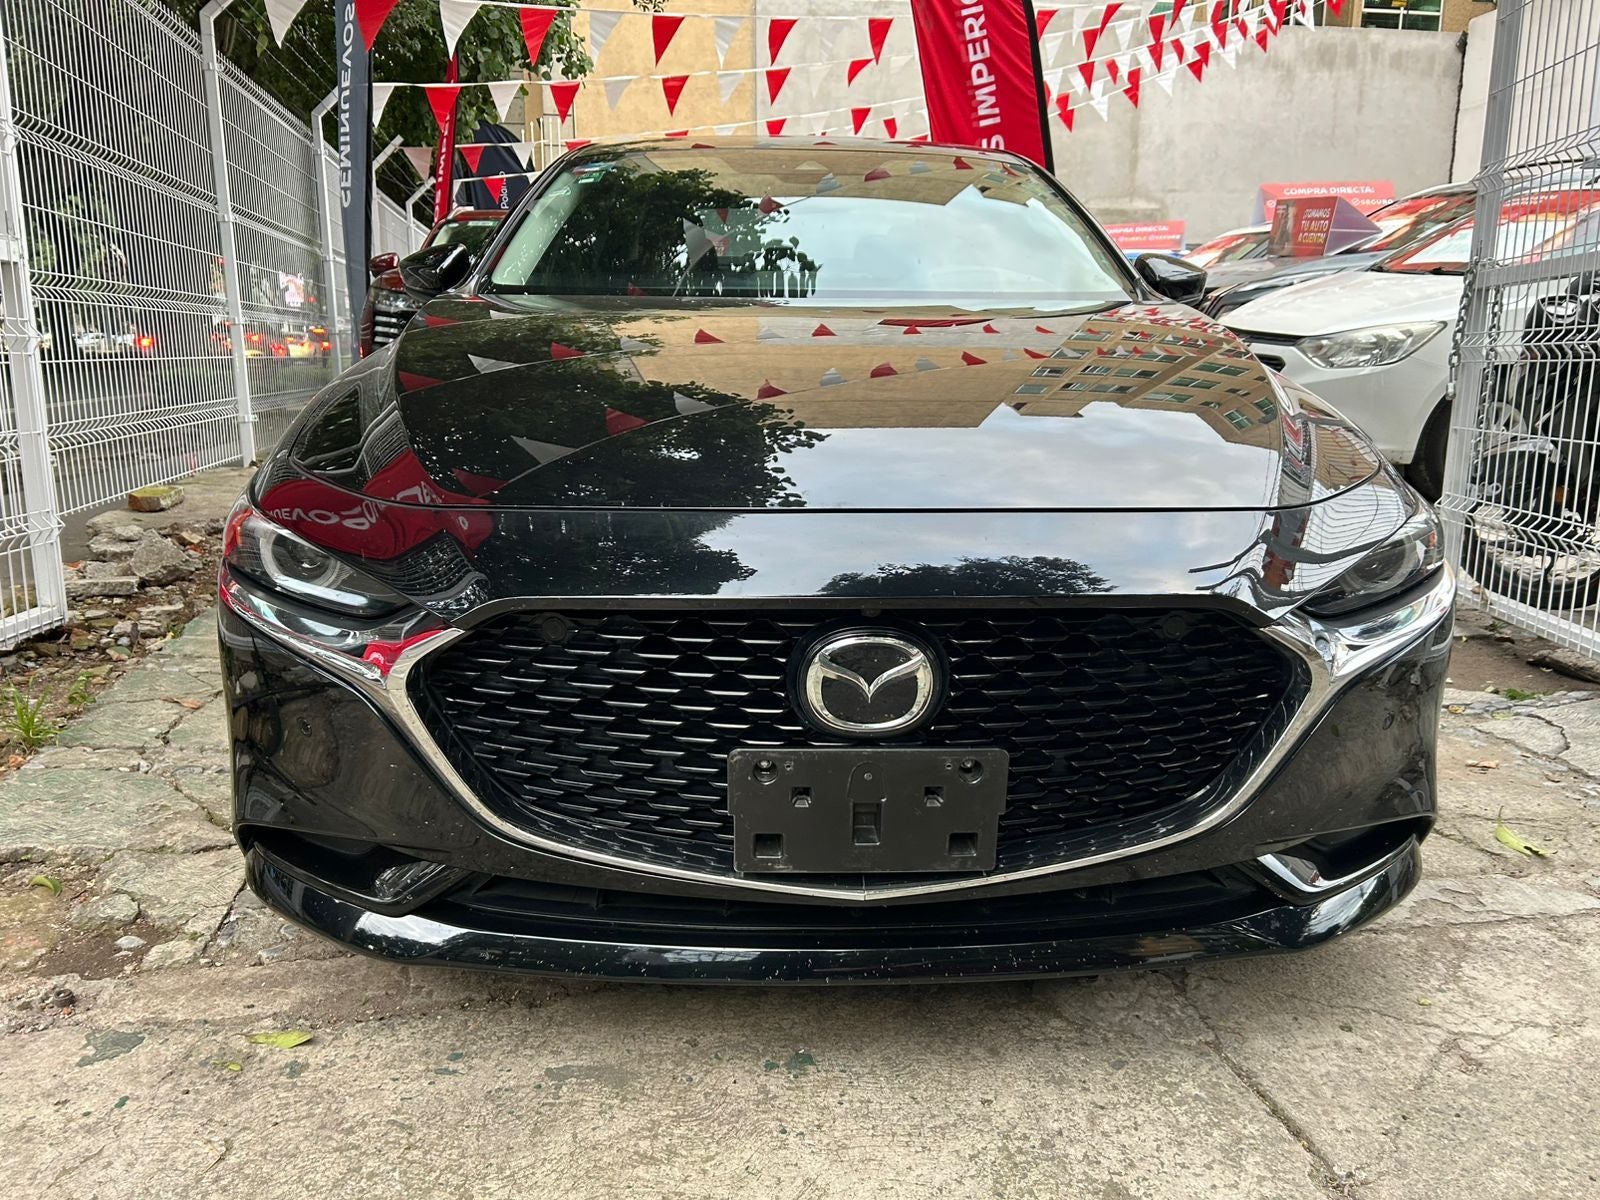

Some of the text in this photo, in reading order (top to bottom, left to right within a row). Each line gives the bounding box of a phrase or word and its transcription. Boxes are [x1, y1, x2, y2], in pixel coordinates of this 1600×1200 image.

[961, 0, 1001, 127] IMPERI
[1283, 186, 1376, 196] COMPRA DIRECTA:
[1309, 220, 1329, 232] AUTO
